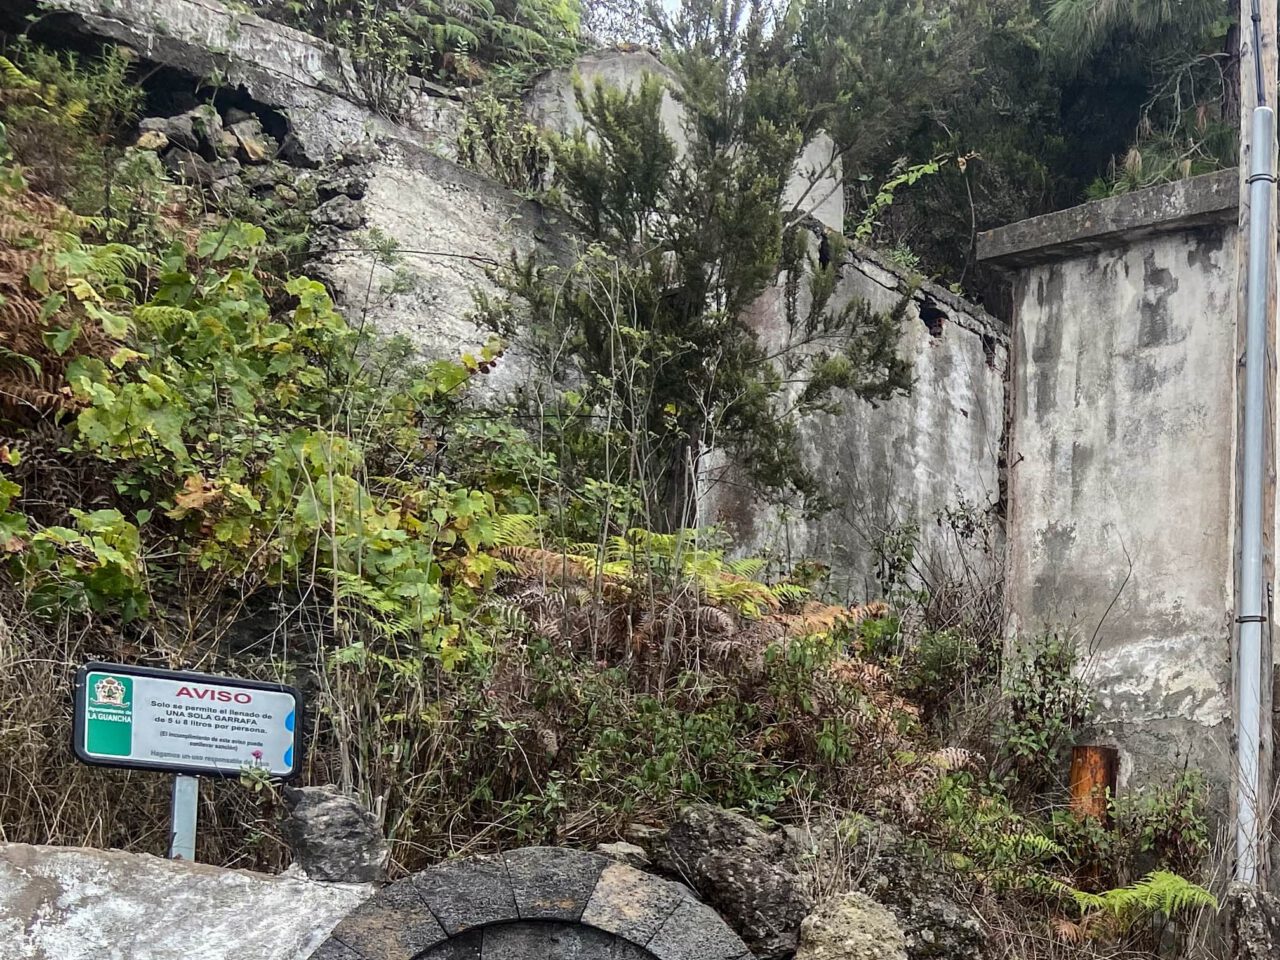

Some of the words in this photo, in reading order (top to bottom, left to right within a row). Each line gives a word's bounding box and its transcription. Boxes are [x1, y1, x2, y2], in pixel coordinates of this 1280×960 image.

[176, 686, 252, 704] AVISO
[151, 700, 170, 708] Solo
[185, 705, 217, 714] permite
[229, 709, 260, 718] llenado
[98, 713, 132, 723] GUANCHA
[188, 712, 212, 720] SOLA
[214, 715, 258, 725] GARRAFA
[191, 720, 212, 728] litros
[214, 723, 228, 731] por
[231, 725, 268, 734] persona.
